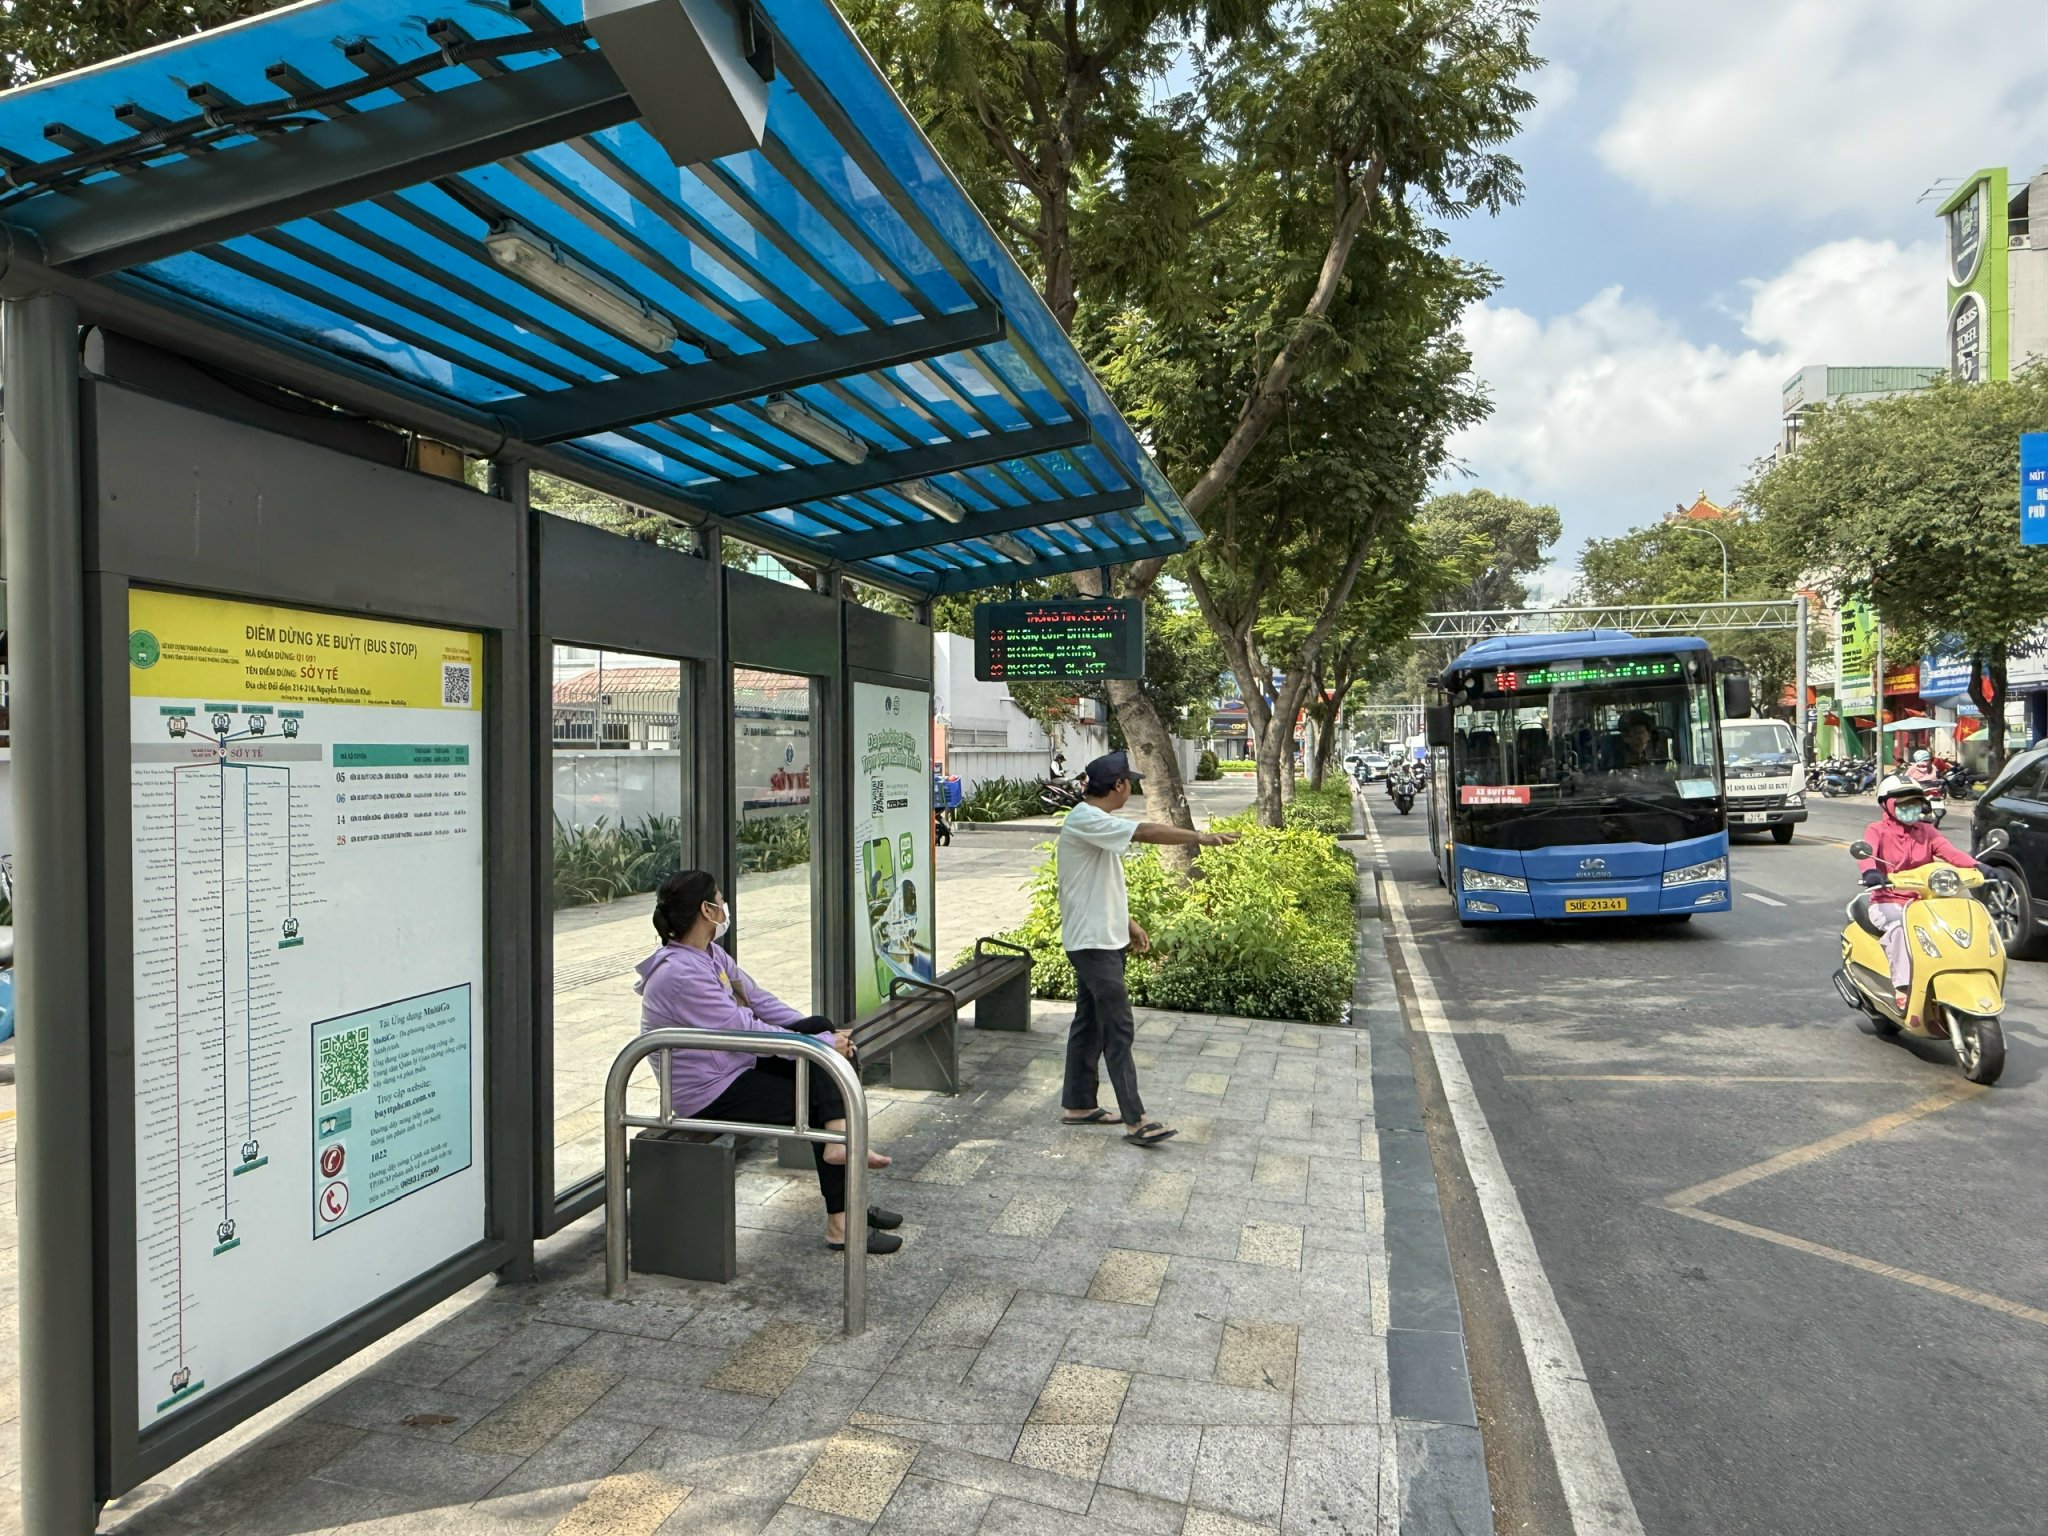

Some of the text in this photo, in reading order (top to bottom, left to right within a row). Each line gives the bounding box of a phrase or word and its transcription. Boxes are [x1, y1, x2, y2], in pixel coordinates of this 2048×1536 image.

[2029, 469, 2046, 481] NÚT
[246, 624, 417, 659] ĐIỂM DỪNG XE BUÝT (BUS STOP)
[300, 664, 315, 679] SỞ
[317, 668, 324, 679] Y
[326, 666, 339, 681] TẾ
[230, 745, 263, 758] SỞ Y TẾ
[336, 772, 345, 782] 05
[336, 793, 345, 803] 06
[337, 815, 345, 825] 14
[371, 1149, 387, 1163] 1022
